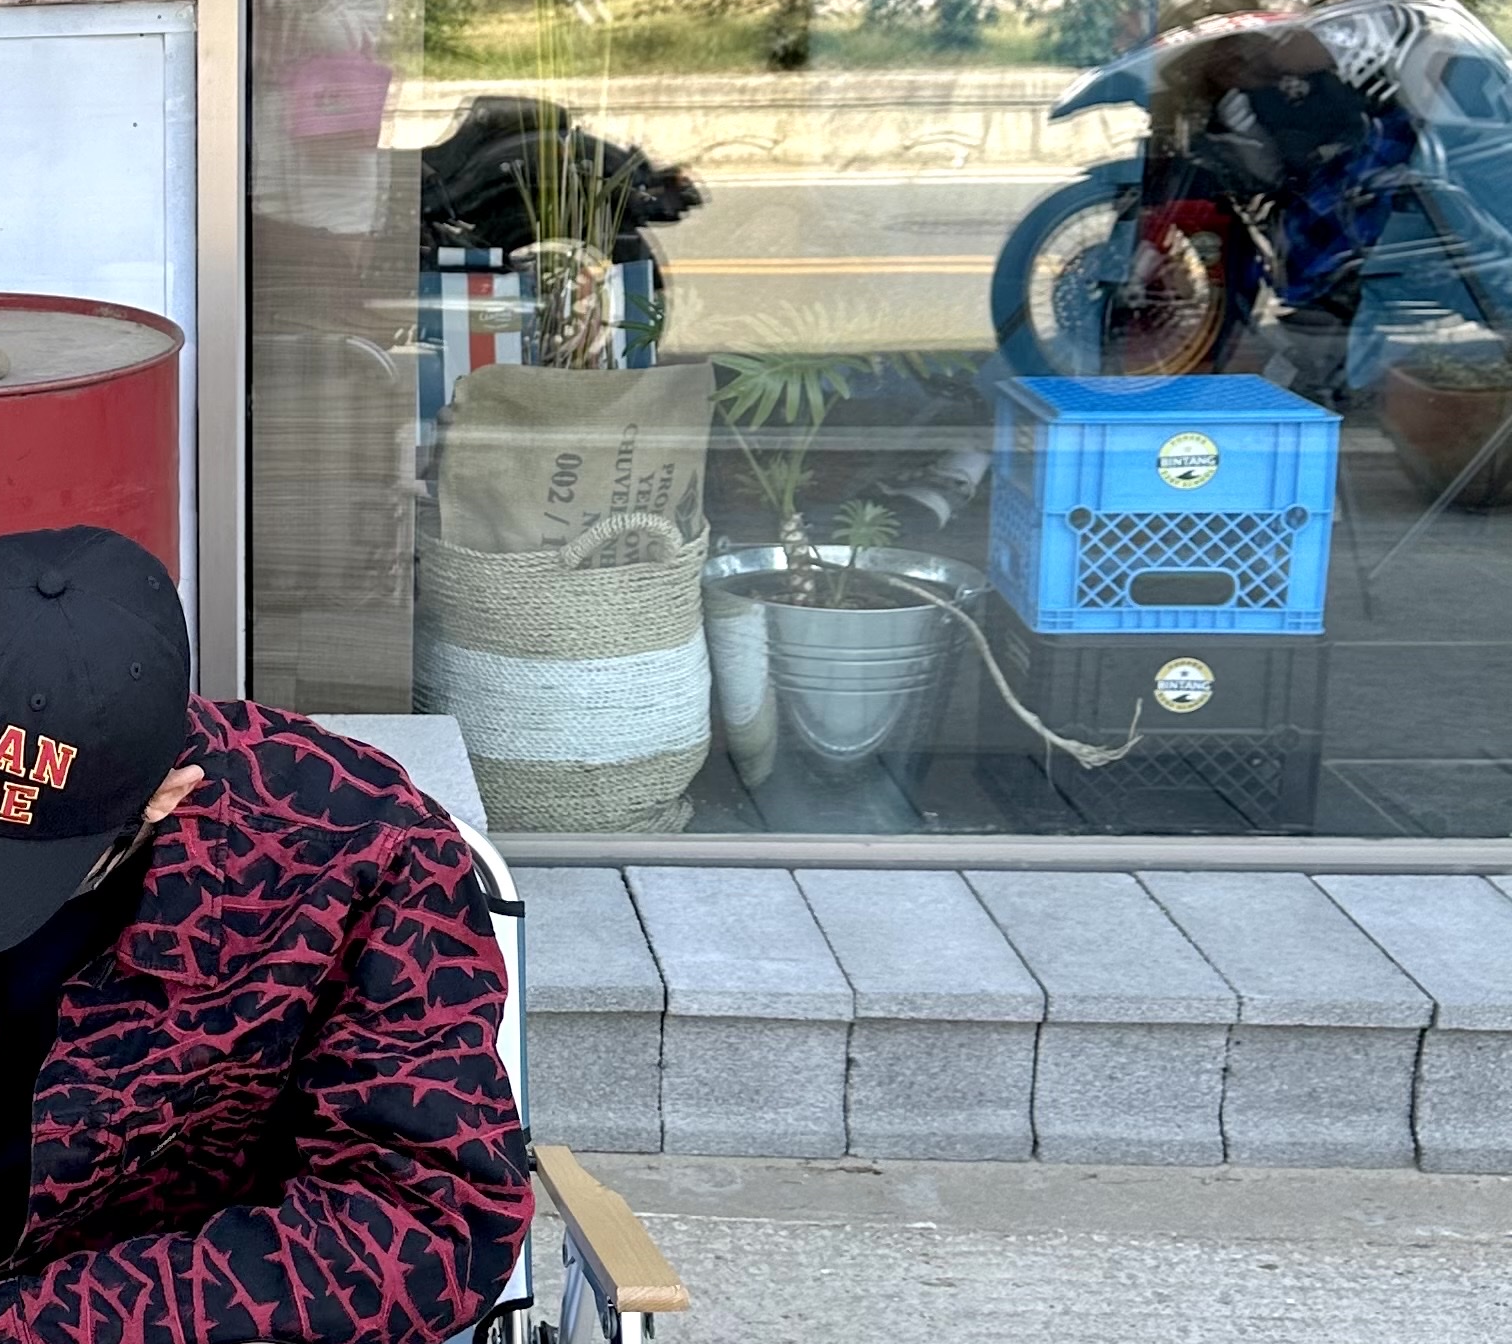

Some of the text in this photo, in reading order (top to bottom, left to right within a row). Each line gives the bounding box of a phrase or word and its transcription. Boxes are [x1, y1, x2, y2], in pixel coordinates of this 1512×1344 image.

[1160, 455, 1216, 467] BINTANG
[547, 453, 583, 504] 002
[1157, 680, 1212, 691] BINTANG
